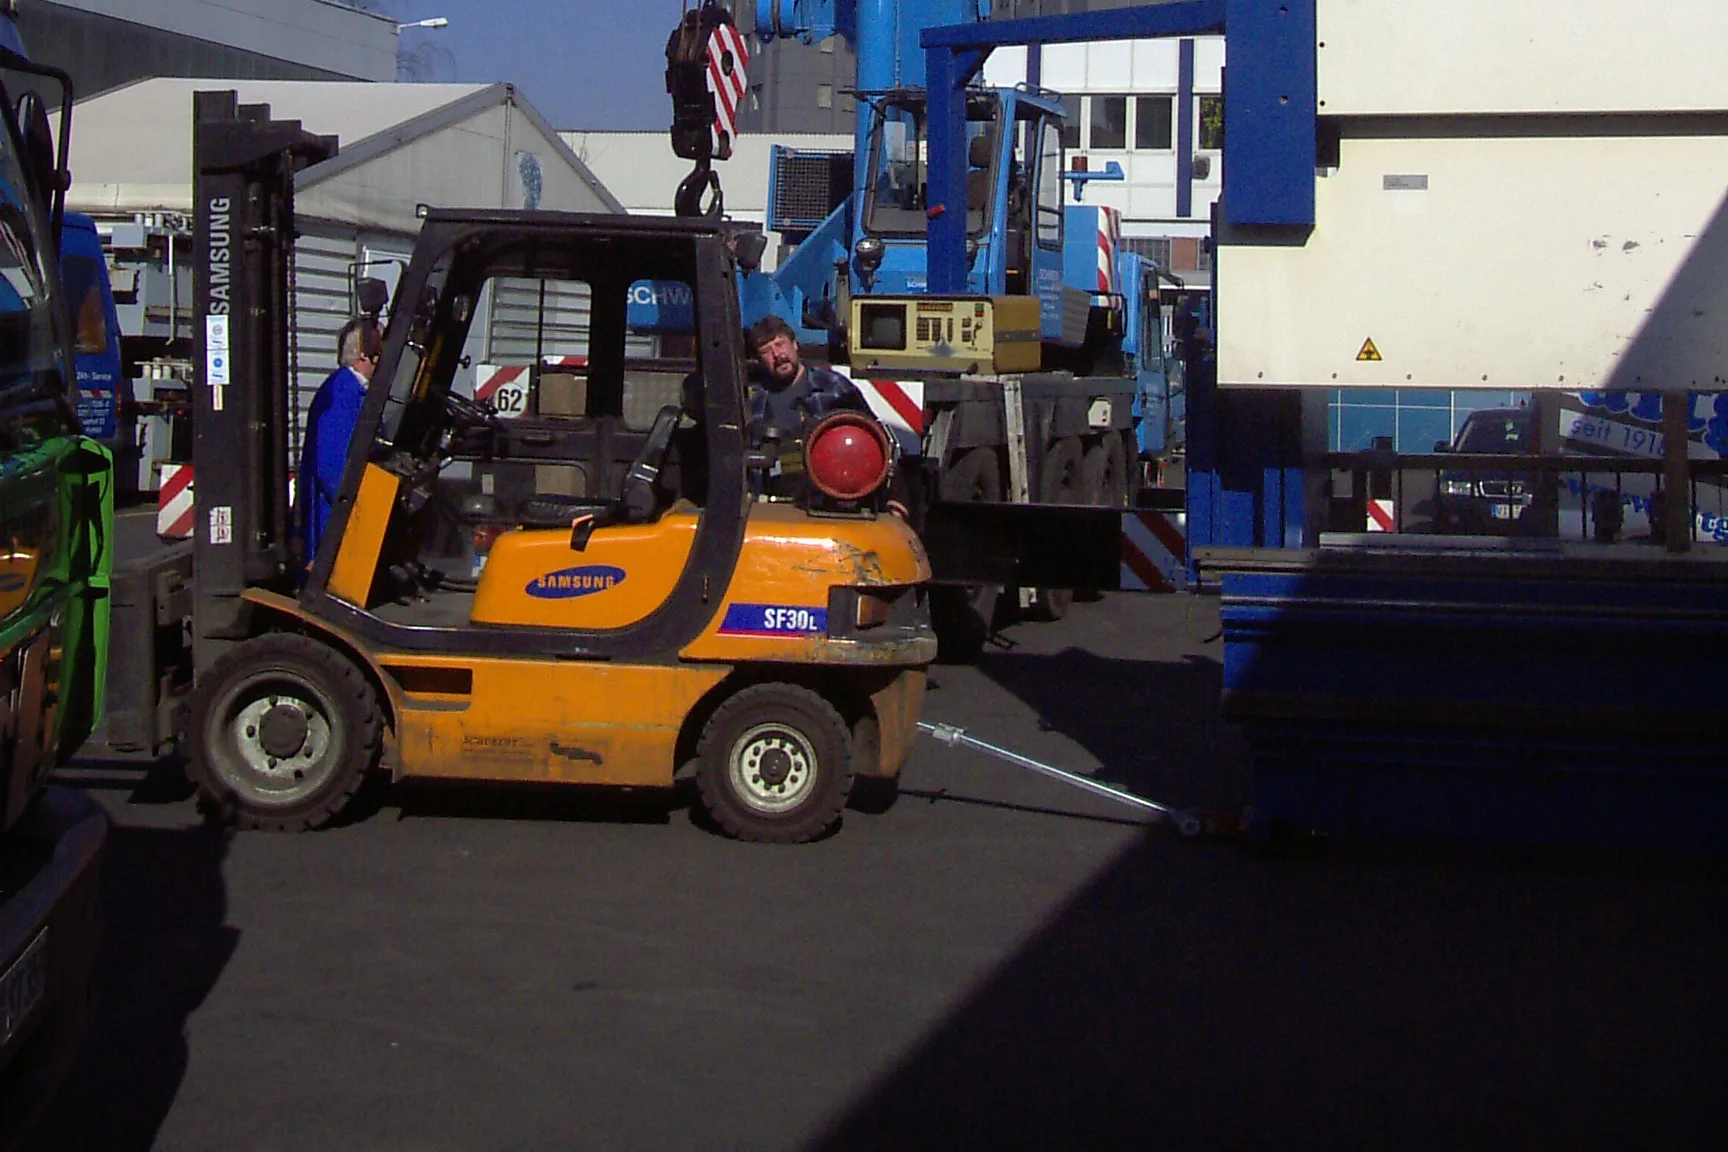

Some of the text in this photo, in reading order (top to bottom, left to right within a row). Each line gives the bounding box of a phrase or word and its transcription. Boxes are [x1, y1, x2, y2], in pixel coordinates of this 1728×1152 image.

[209, 197, 231, 315] SAMSUNG
[627, 286, 693, 304] SCHW
[498, 389, 522, 411] 62
[1571, 419, 1612, 442] seit
[537, 574, 616, 589] SAMSUNG
[764, 608, 818, 631] SF30L
